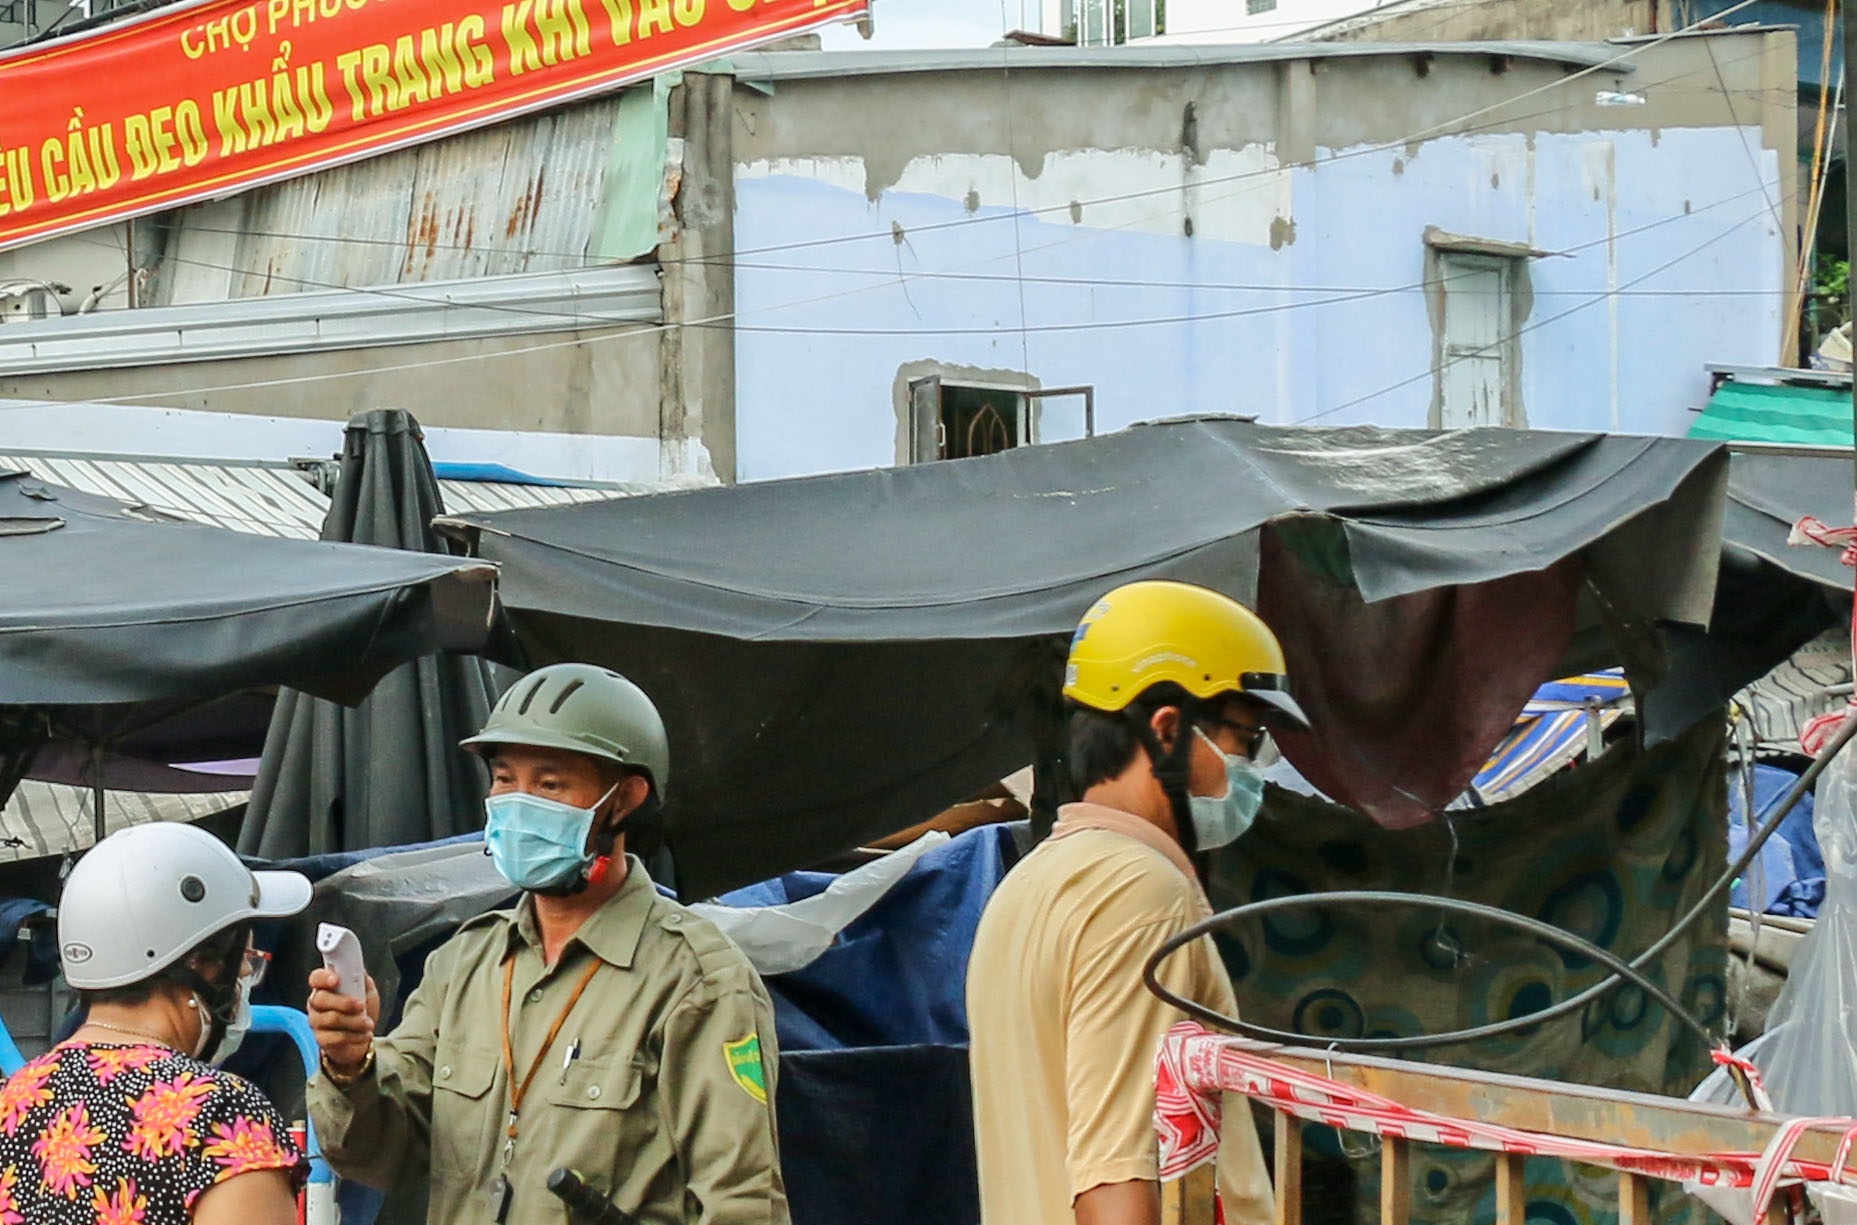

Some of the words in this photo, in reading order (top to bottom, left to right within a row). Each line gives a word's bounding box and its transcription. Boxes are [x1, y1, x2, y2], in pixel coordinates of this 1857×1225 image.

[180, 6, 257, 59] CHỢ
[40, 107, 121, 203] CẦU
[124, 99, 209, 182] ĐEO
[212, 40, 334, 157] KHẨU
[336, 14, 495, 121] TRANG
[500, 0, 592, 77] KHI
